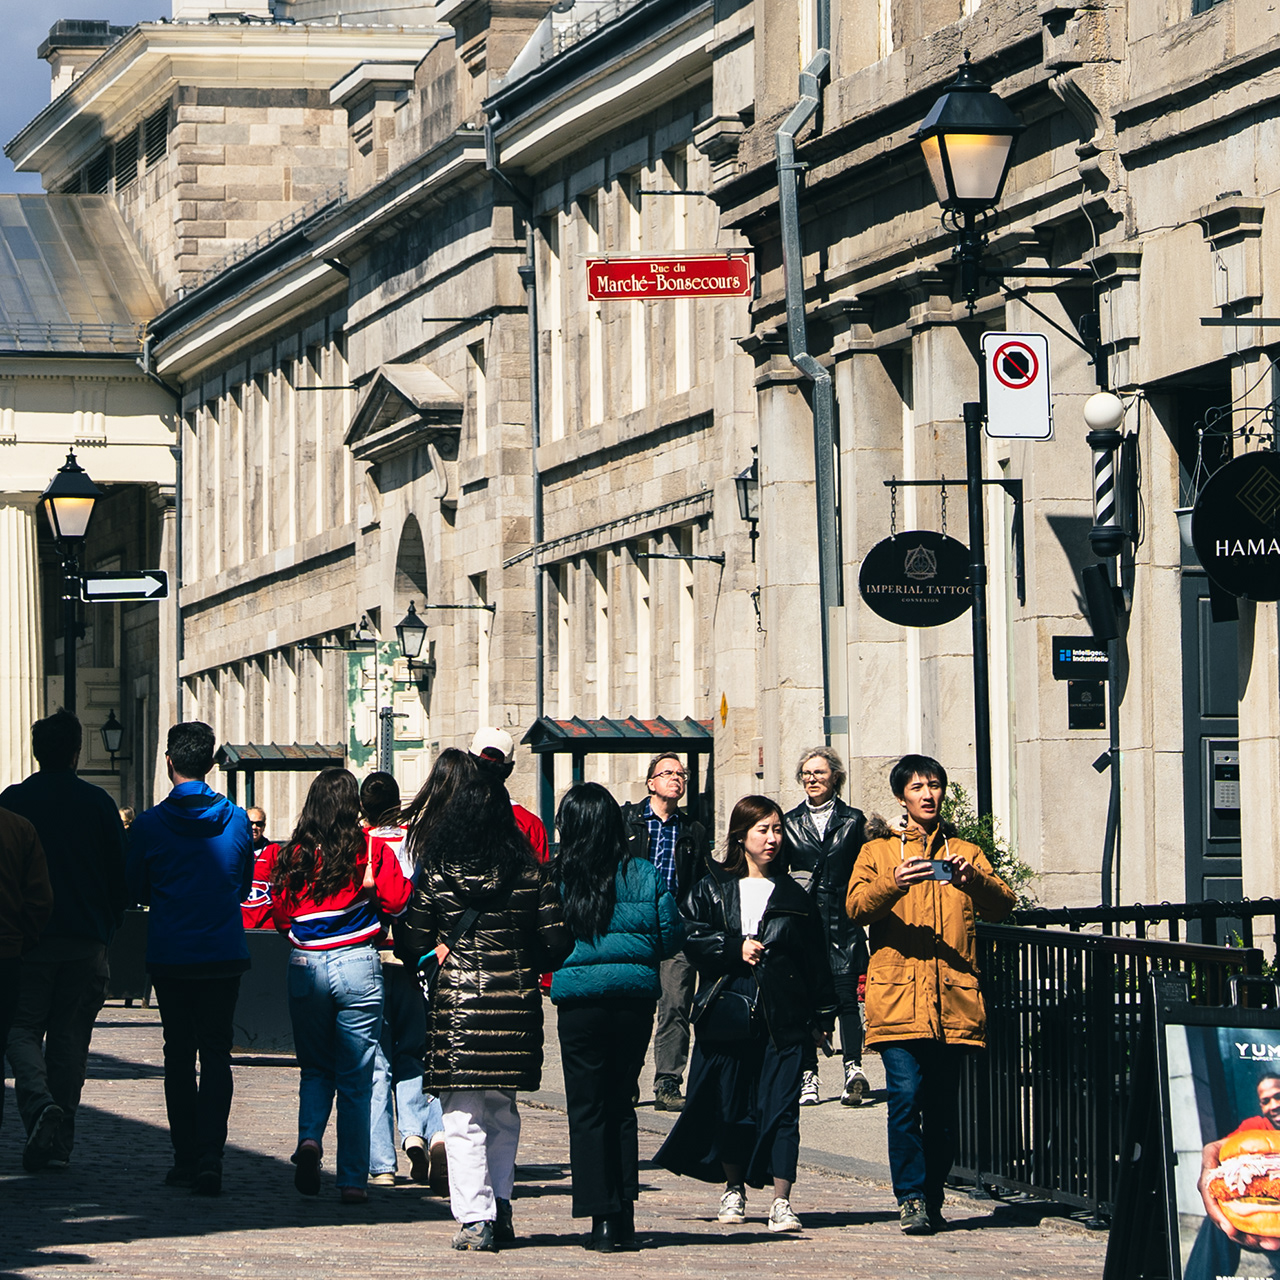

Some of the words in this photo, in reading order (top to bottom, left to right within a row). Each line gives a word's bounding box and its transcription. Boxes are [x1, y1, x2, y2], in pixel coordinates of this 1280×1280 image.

[650, 263, 670, 274] Rue
[673, 262, 686, 273] du
[597, 274, 741, 293] Marché-Bonsecours
[866, 584, 923, 594] IMPERIAL
[1072, 649, 1106, 657] Intelligenc
